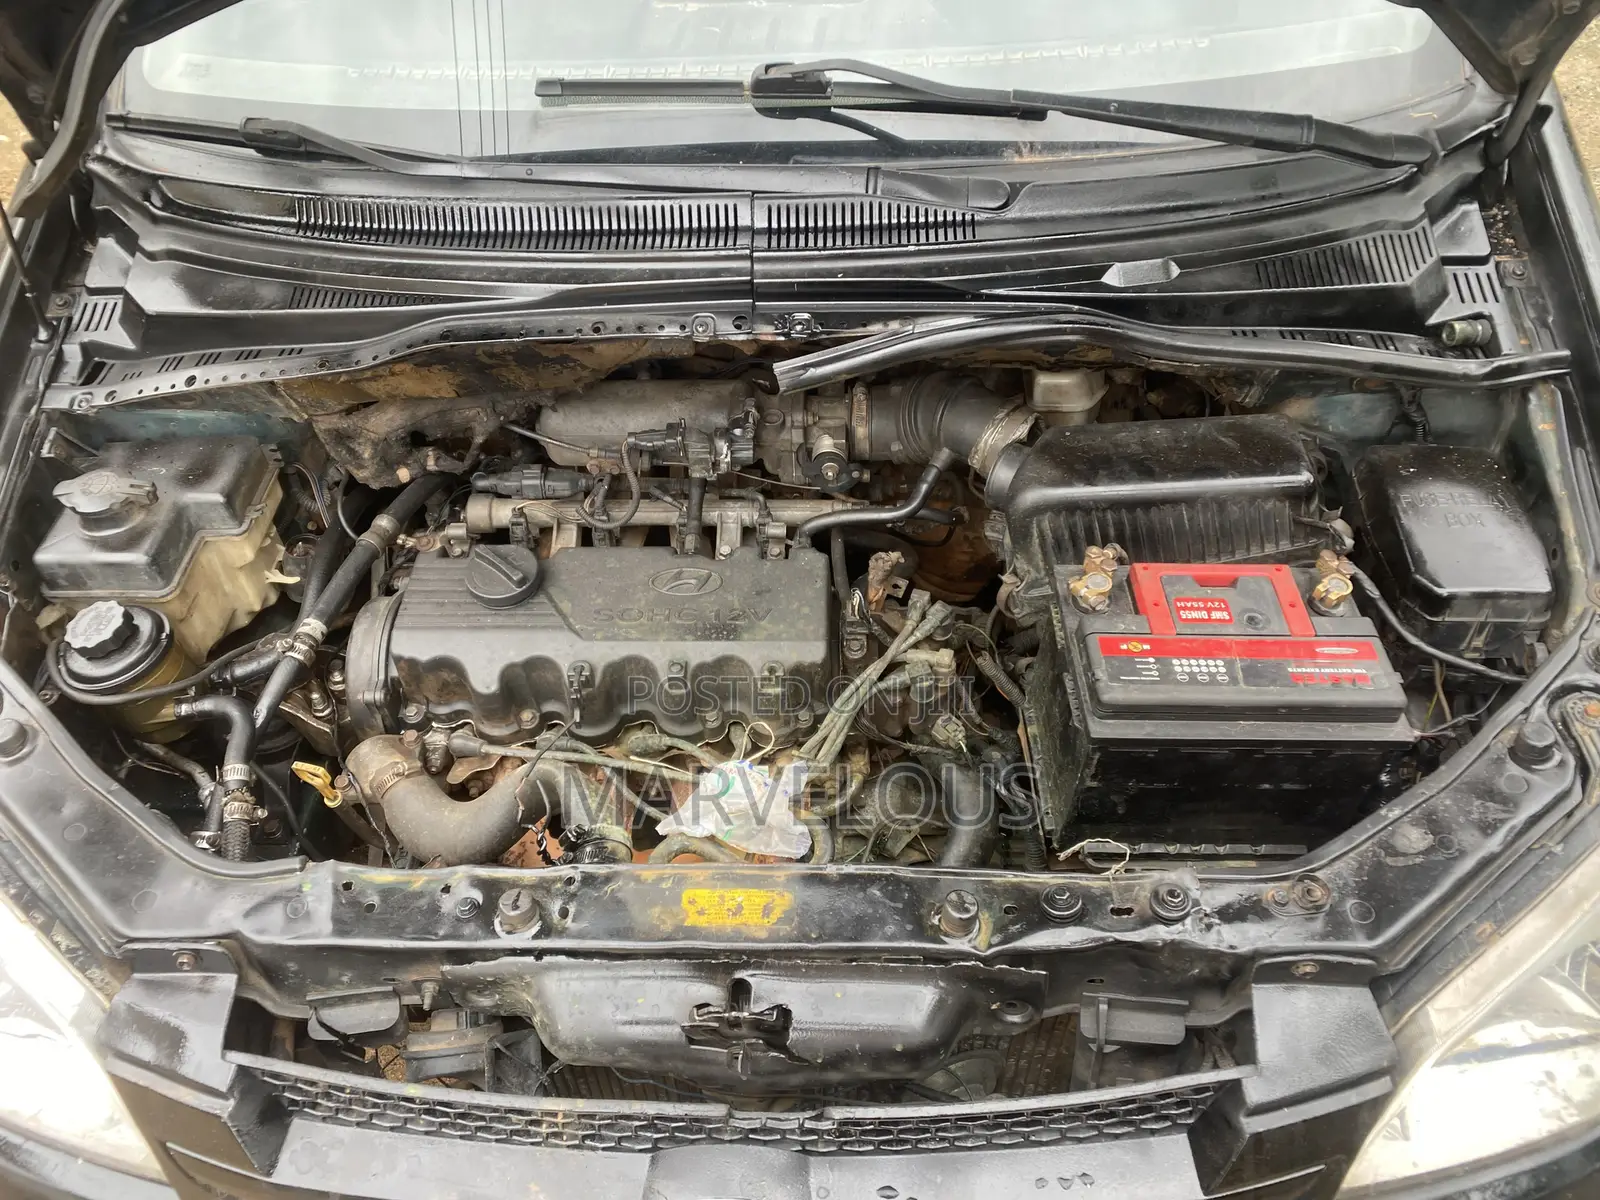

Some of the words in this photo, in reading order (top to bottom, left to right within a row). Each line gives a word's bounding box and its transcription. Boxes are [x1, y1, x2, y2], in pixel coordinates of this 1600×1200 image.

[1446, 512, 1485, 527] BOX
[592, 607, 698, 624] SOHC
[711, 607, 773, 624] 12V
[1180, 610, 1209, 619] DIN55
[1210, 611, 1230, 620] SMF
